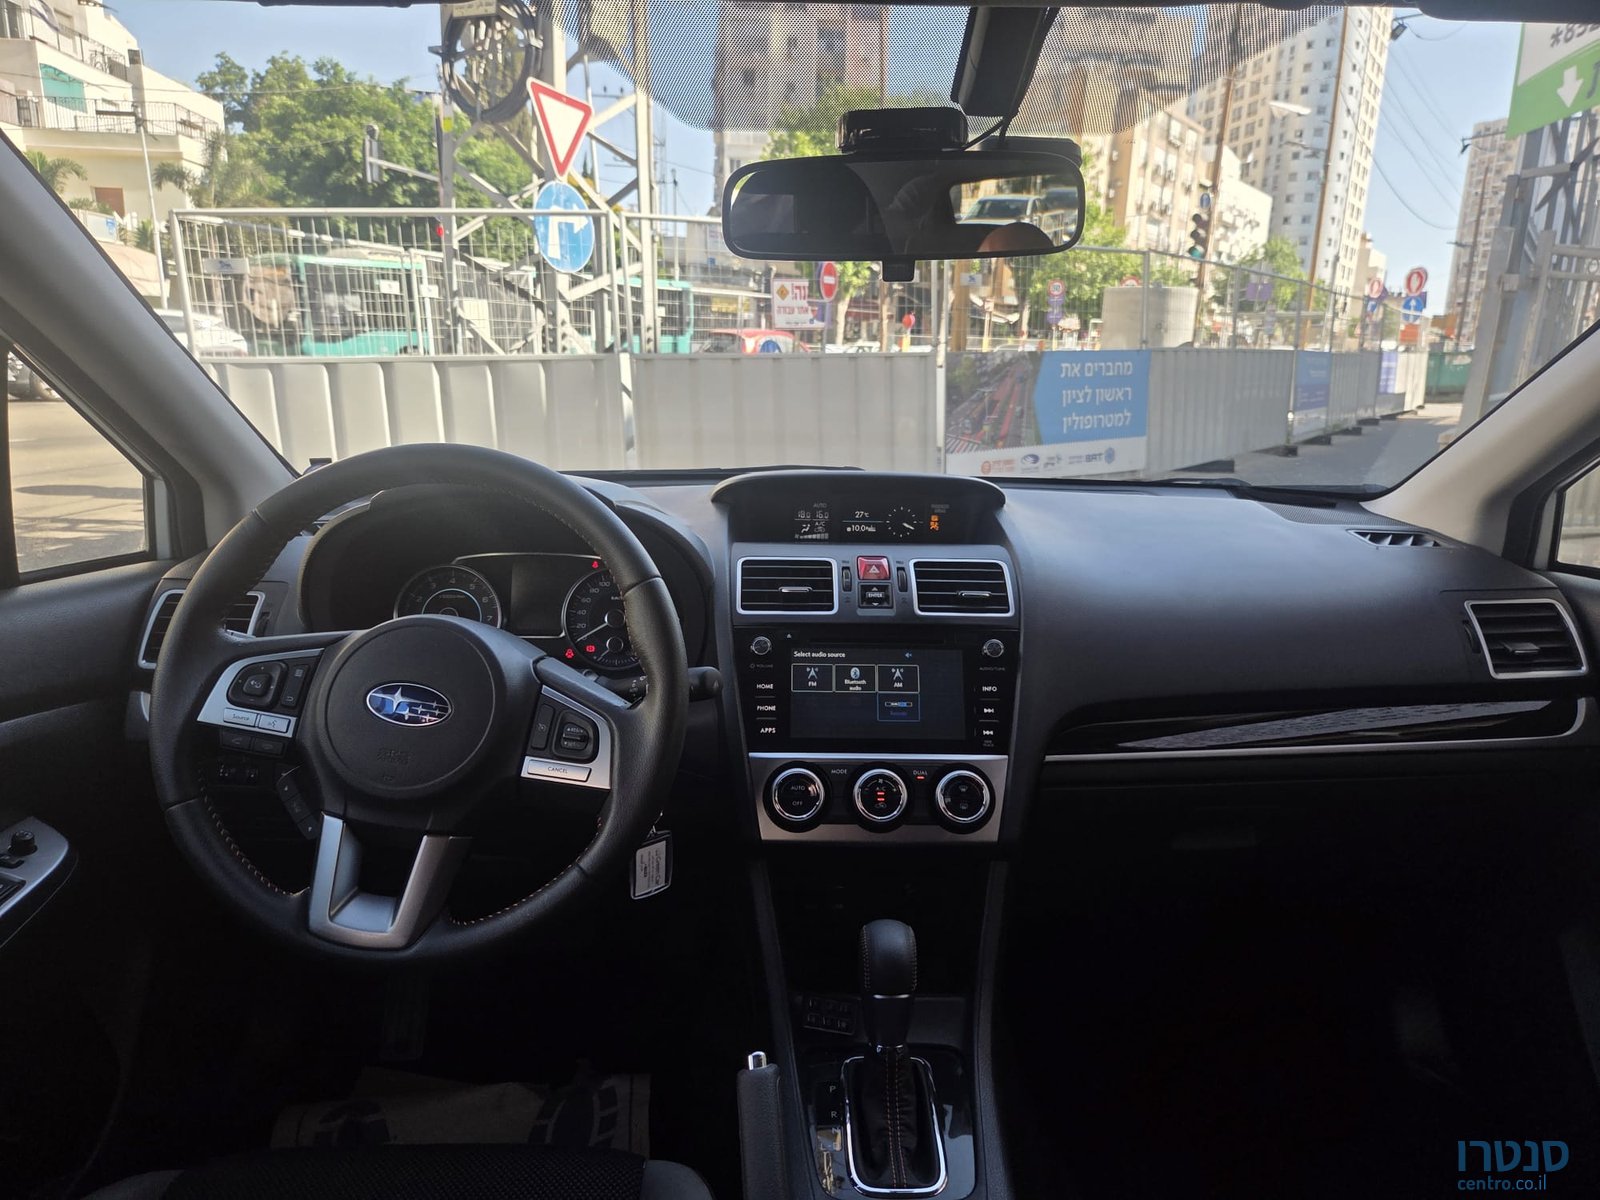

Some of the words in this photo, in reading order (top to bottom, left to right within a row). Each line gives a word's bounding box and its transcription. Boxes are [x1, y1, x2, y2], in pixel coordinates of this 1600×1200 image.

[1060, 363, 1081, 378] את
[1085, 361, 1133, 376] מחברים
[1062, 384, 1092, 407] לציון
[1095, 387, 1132, 406] ראשון
[1063, 408, 1132, 434] למטרופולין
[793, 650, 811, 658] Select
[548, 766, 568, 774] CANCEL
[830, 1085, 836, 1093] P
[831, 1110, 838, 1118] R
